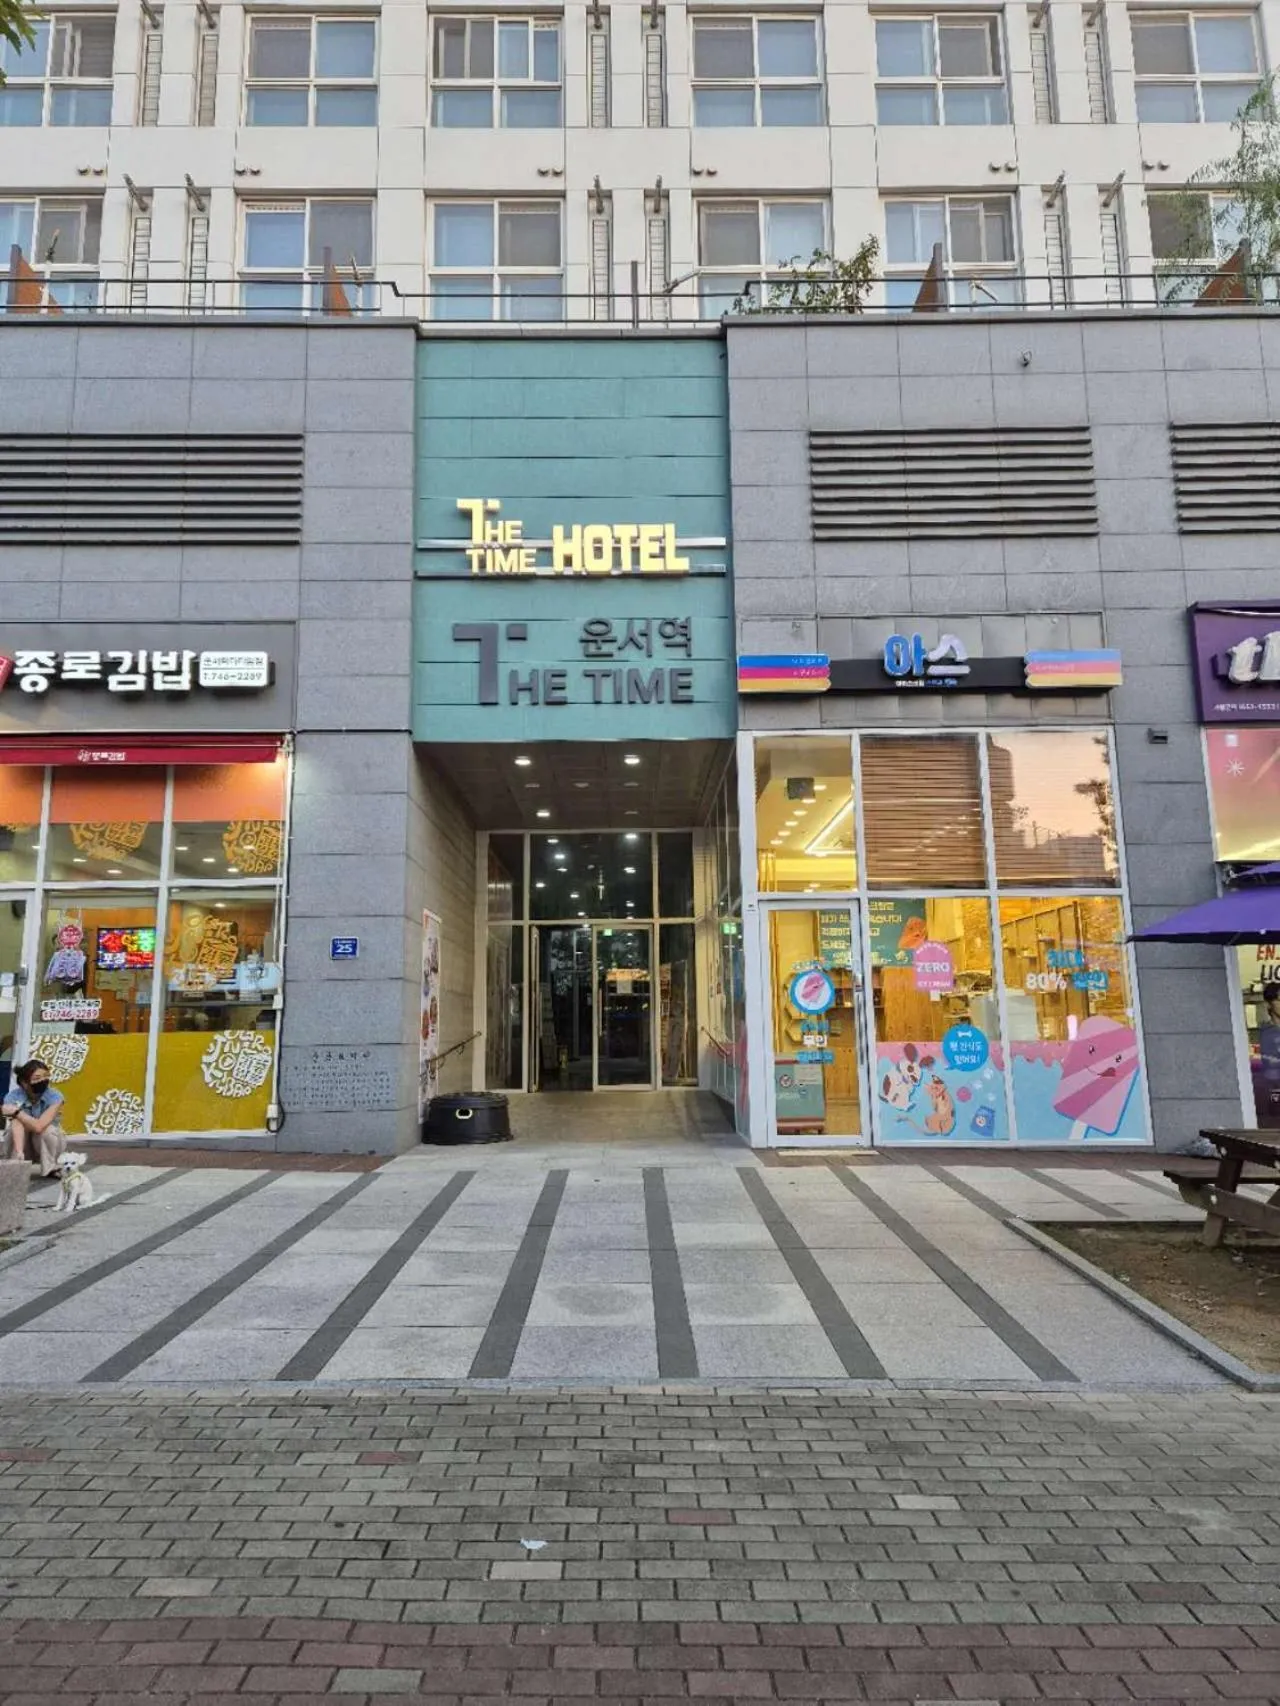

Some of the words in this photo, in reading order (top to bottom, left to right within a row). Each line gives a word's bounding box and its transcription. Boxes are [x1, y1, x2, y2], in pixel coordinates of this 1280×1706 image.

[457, 499, 523, 545] THE
[466, 548, 537, 573] TIME
[552, 523, 690, 573] HOTEL
[579, 617, 692, 657] 운서역
[14, 650, 196, 693] 종로김밥
[453, 623, 567, 705] THE
[583, 668, 694, 704] TIME
[335, 944, 353, 953] 25
[916, 962, 950, 973] ZERO
[1026, 972, 1068, 990] 80%
